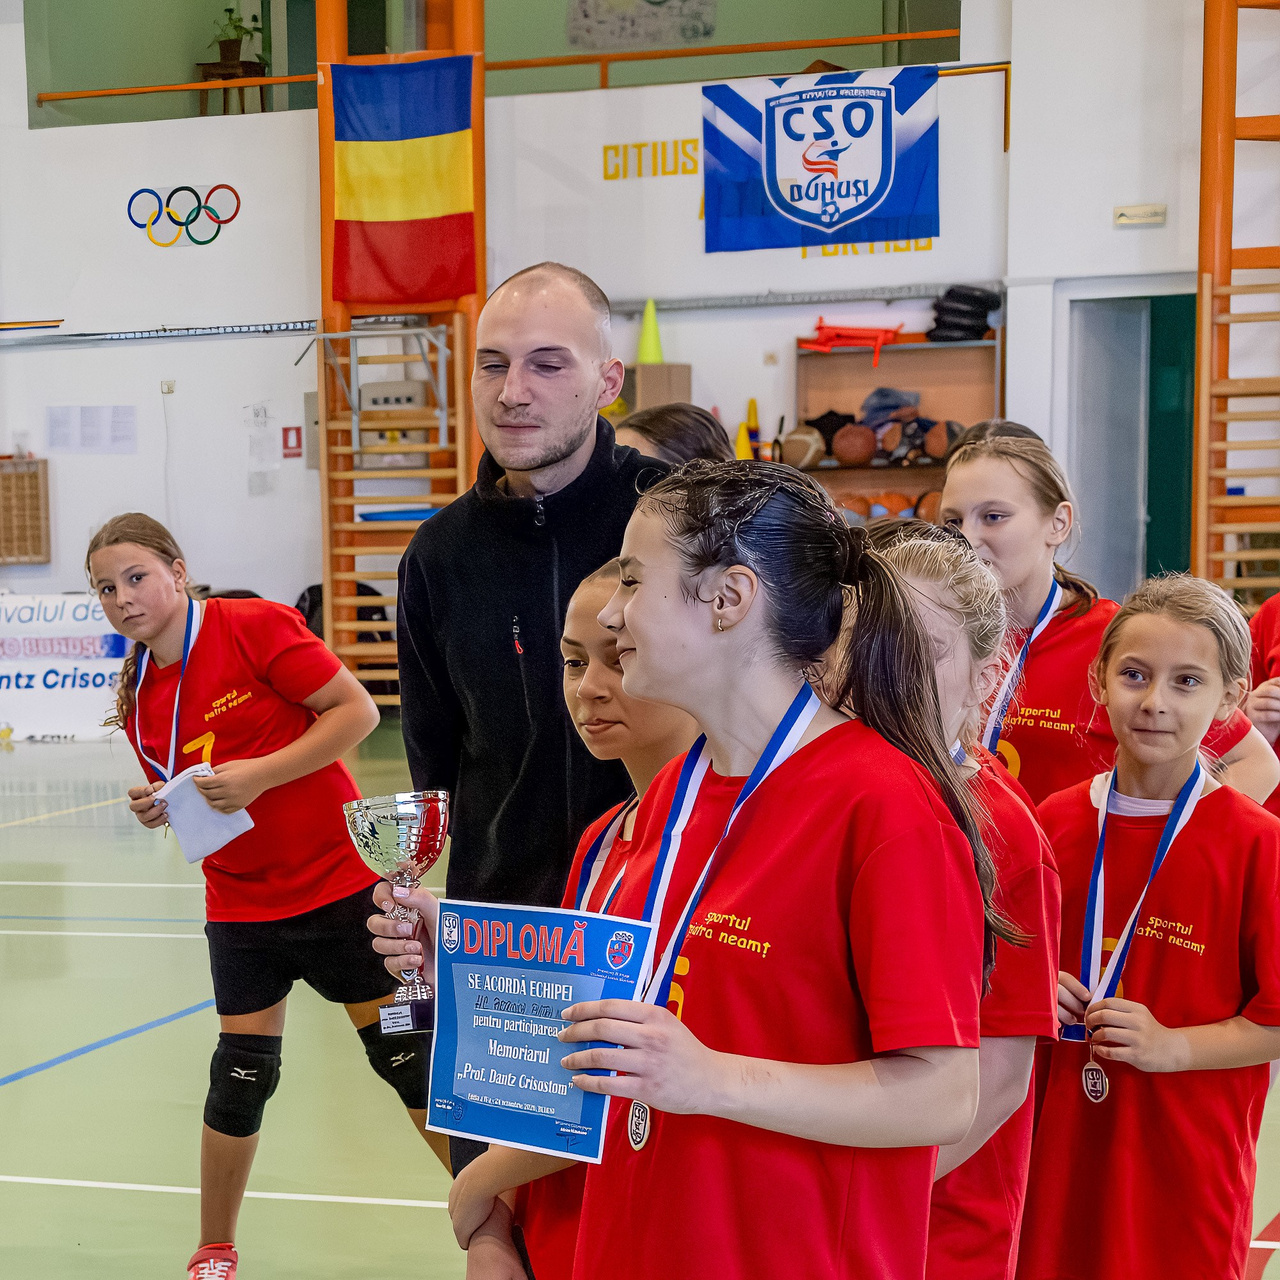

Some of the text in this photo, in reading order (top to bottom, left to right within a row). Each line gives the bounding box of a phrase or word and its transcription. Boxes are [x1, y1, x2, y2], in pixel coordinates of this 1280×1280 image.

[782, 101, 875, 142] CSO
[603, 138, 699, 180] CITIUS
[42, 667, 120, 690] Crisos
[1019, 707, 1061, 719] sportul
[182, 730, 216, 763] 7
[705, 911, 752, 931] sportul
[1147, 916, 1194, 936] sportul
[463, 919, 586, 967] DIPLOMĂ
[468, 972, 481, 990] SE
[529, 980, 573, 1001] ECHIPEI
[473, 1014, 502, 1028] pentru
[503, 1018, 558, 1037] participarea
[488, 1069, 516, 1088] Dantz
